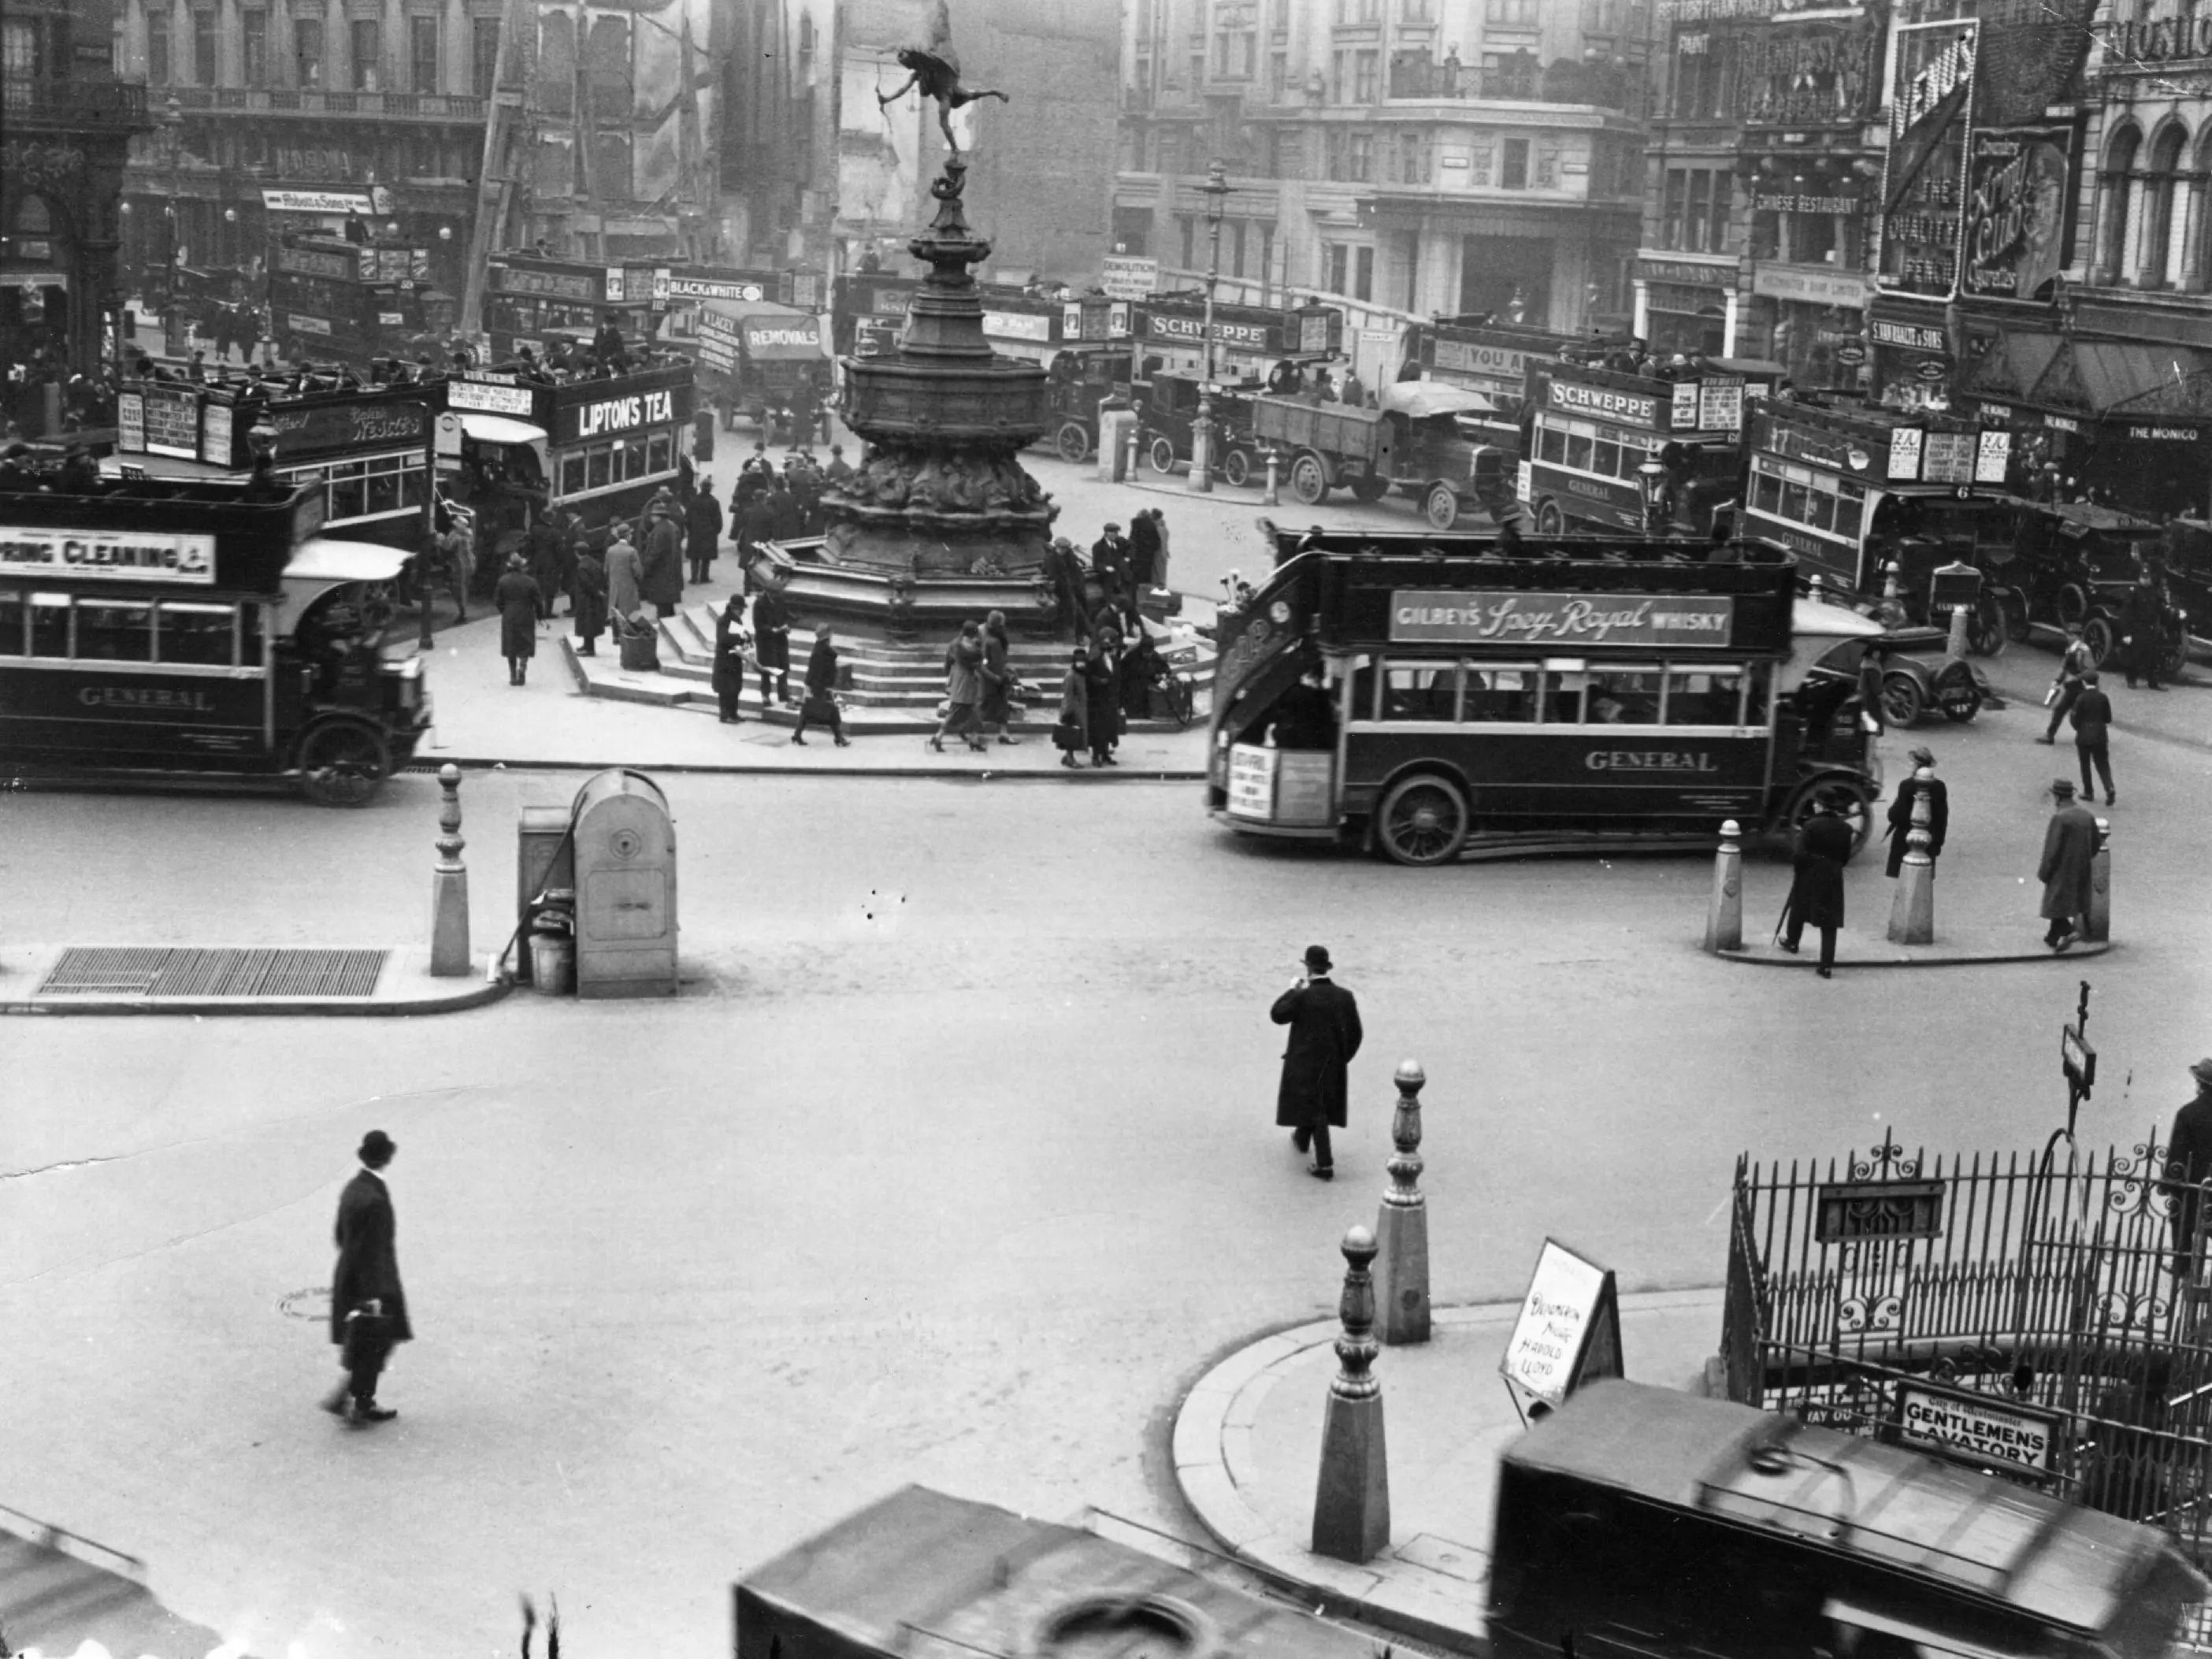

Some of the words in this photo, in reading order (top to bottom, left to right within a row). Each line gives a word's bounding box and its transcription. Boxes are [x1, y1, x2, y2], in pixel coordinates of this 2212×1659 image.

[1894, 28, 1974, 139] VENUS
[1921, 178, 1950, 203] THE
[1757, 194, 1794, 211] CHINESE
[1798, 195, 1858, 213] RESTAURANT
[1888, 215, 1955, 244] QUALITY
[1104, 261, 1156, 273] DEMOLITION
[670, 281, 704, 295] BLACK
[710, 285, 743, 299] WHITE
[749, 330, 818, 346] REMOVALS
[1923, 329, 1942, 349] SONS
[1471, 347, 1504, 366] YOU
[579, 396, 641, 437] LIPTON'S
[644, 390, 673, 423] TEA
[2130, 427, 2149, 438] THE
[2152, 428, 2198, 440] MONICO
[1568, 480, 1610, 500] GENERAL
[1957, 486, 1969, 499] 6
[62, 541, 177, 568] CLEANING
[1397, 601, 1481, 625] GILBEY'S
[1479, 599, 1558, 640] Spey
[1553, 600, 1653, 640] Royal
[1650, 611, 1727, 630] WHISKY
[78, 687, 216, 711] GENERAL
[1585, 752, 1719, 771] GENERAL
[1906, 1402, 2044, 1450] GENTLEMEN'S
